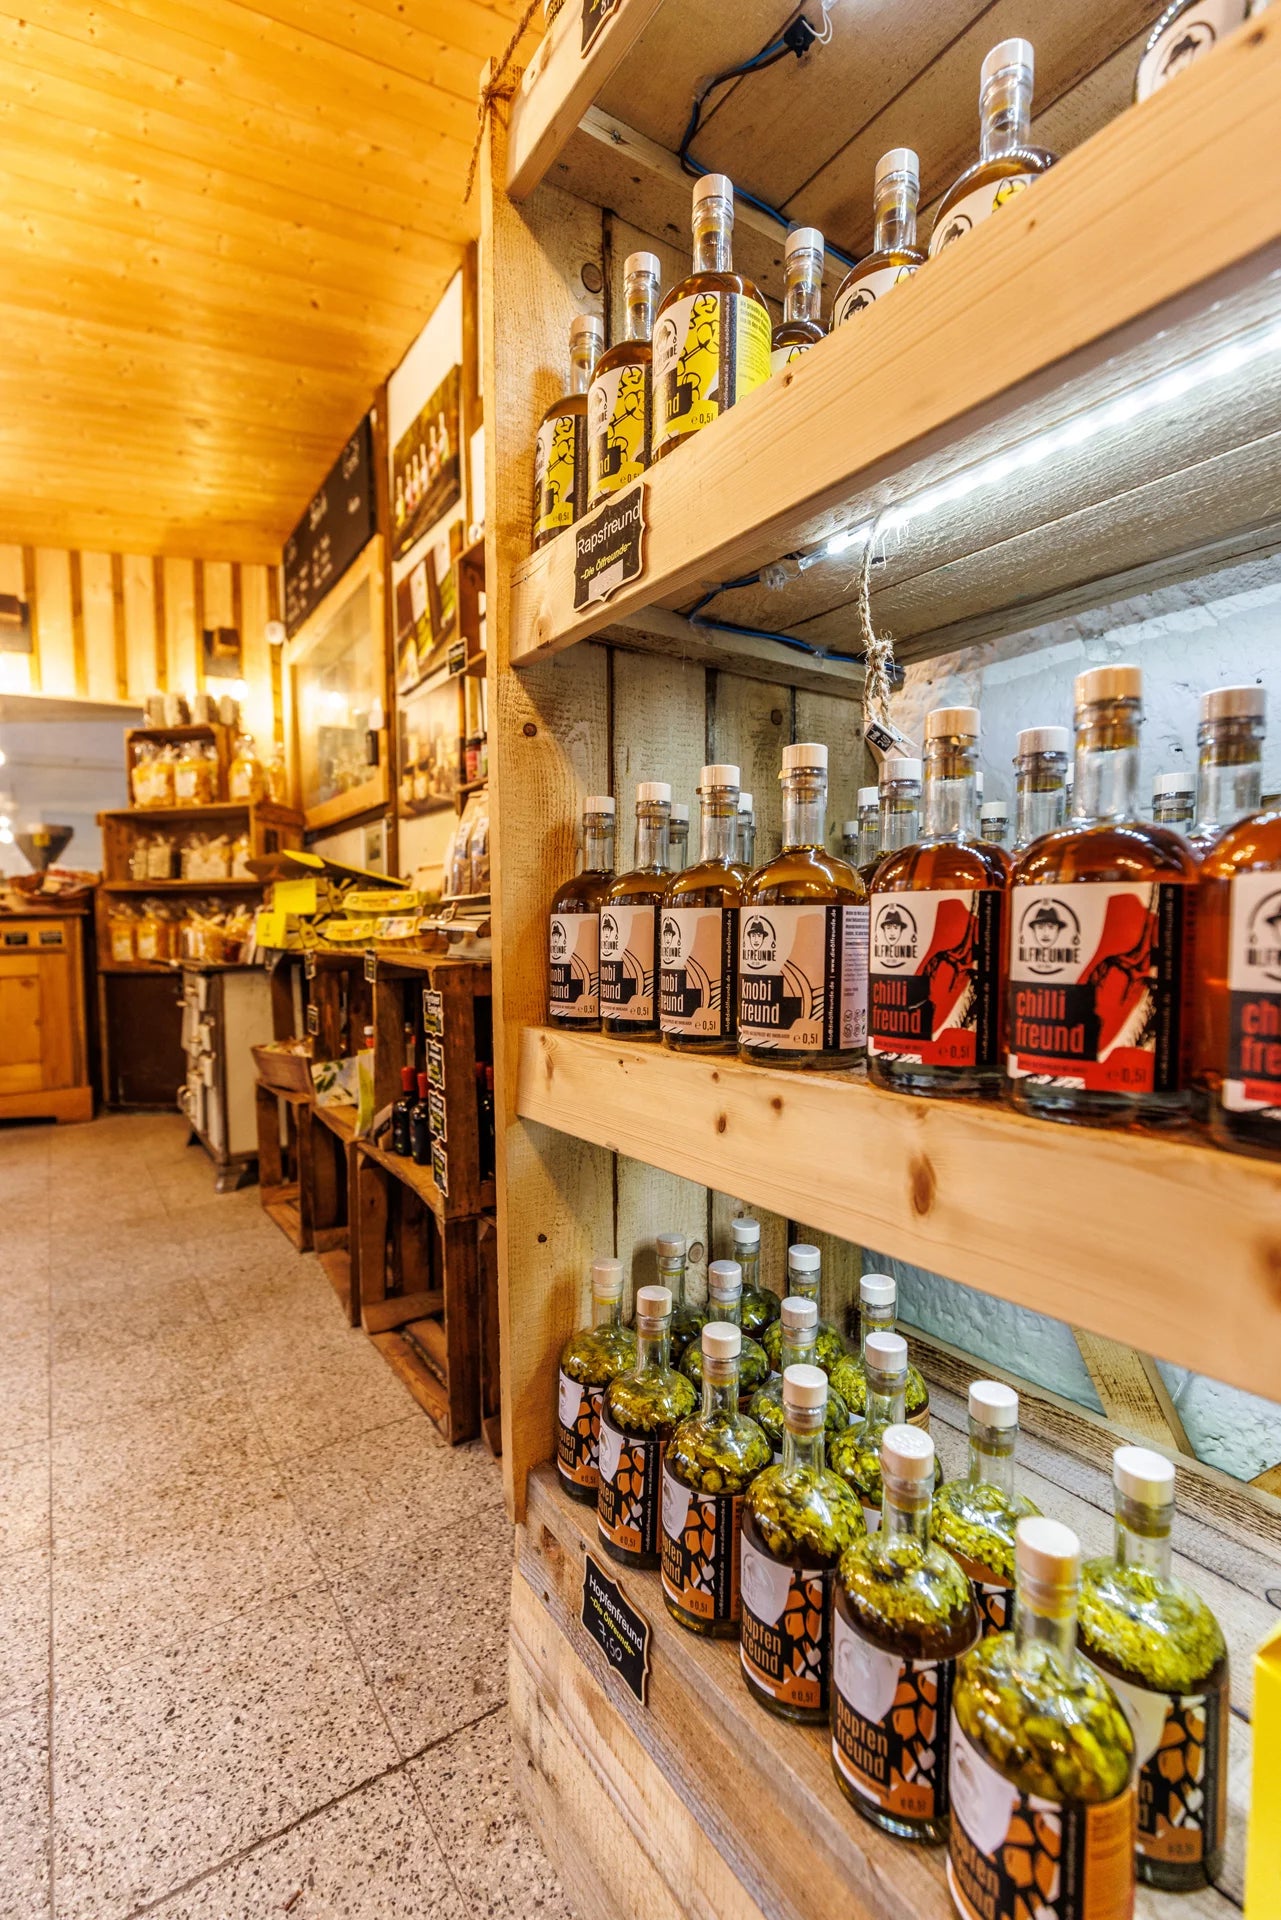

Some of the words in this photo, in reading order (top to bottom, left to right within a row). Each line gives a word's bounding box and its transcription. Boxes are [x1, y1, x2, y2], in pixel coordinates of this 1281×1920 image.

[576, 499, 640, 558] Rapsfreund
[741, 978, 772, 1001] knobi
[873, 980, 908, 1006] chilli
[1016, 989, 1066, 1020] chilli
[741, 1000, 780, 1024] freund
[872, 1006, 921, 1033] freund
[1016, 1018, 1084, 1053] freund
[589, 1574, 643, 1652] Hopfenfreund
[598, 1619, 623, 1662] 7,50
[837, 1694, 888, 1758] hopfen
[836, 1719, 885, 1780] freund
